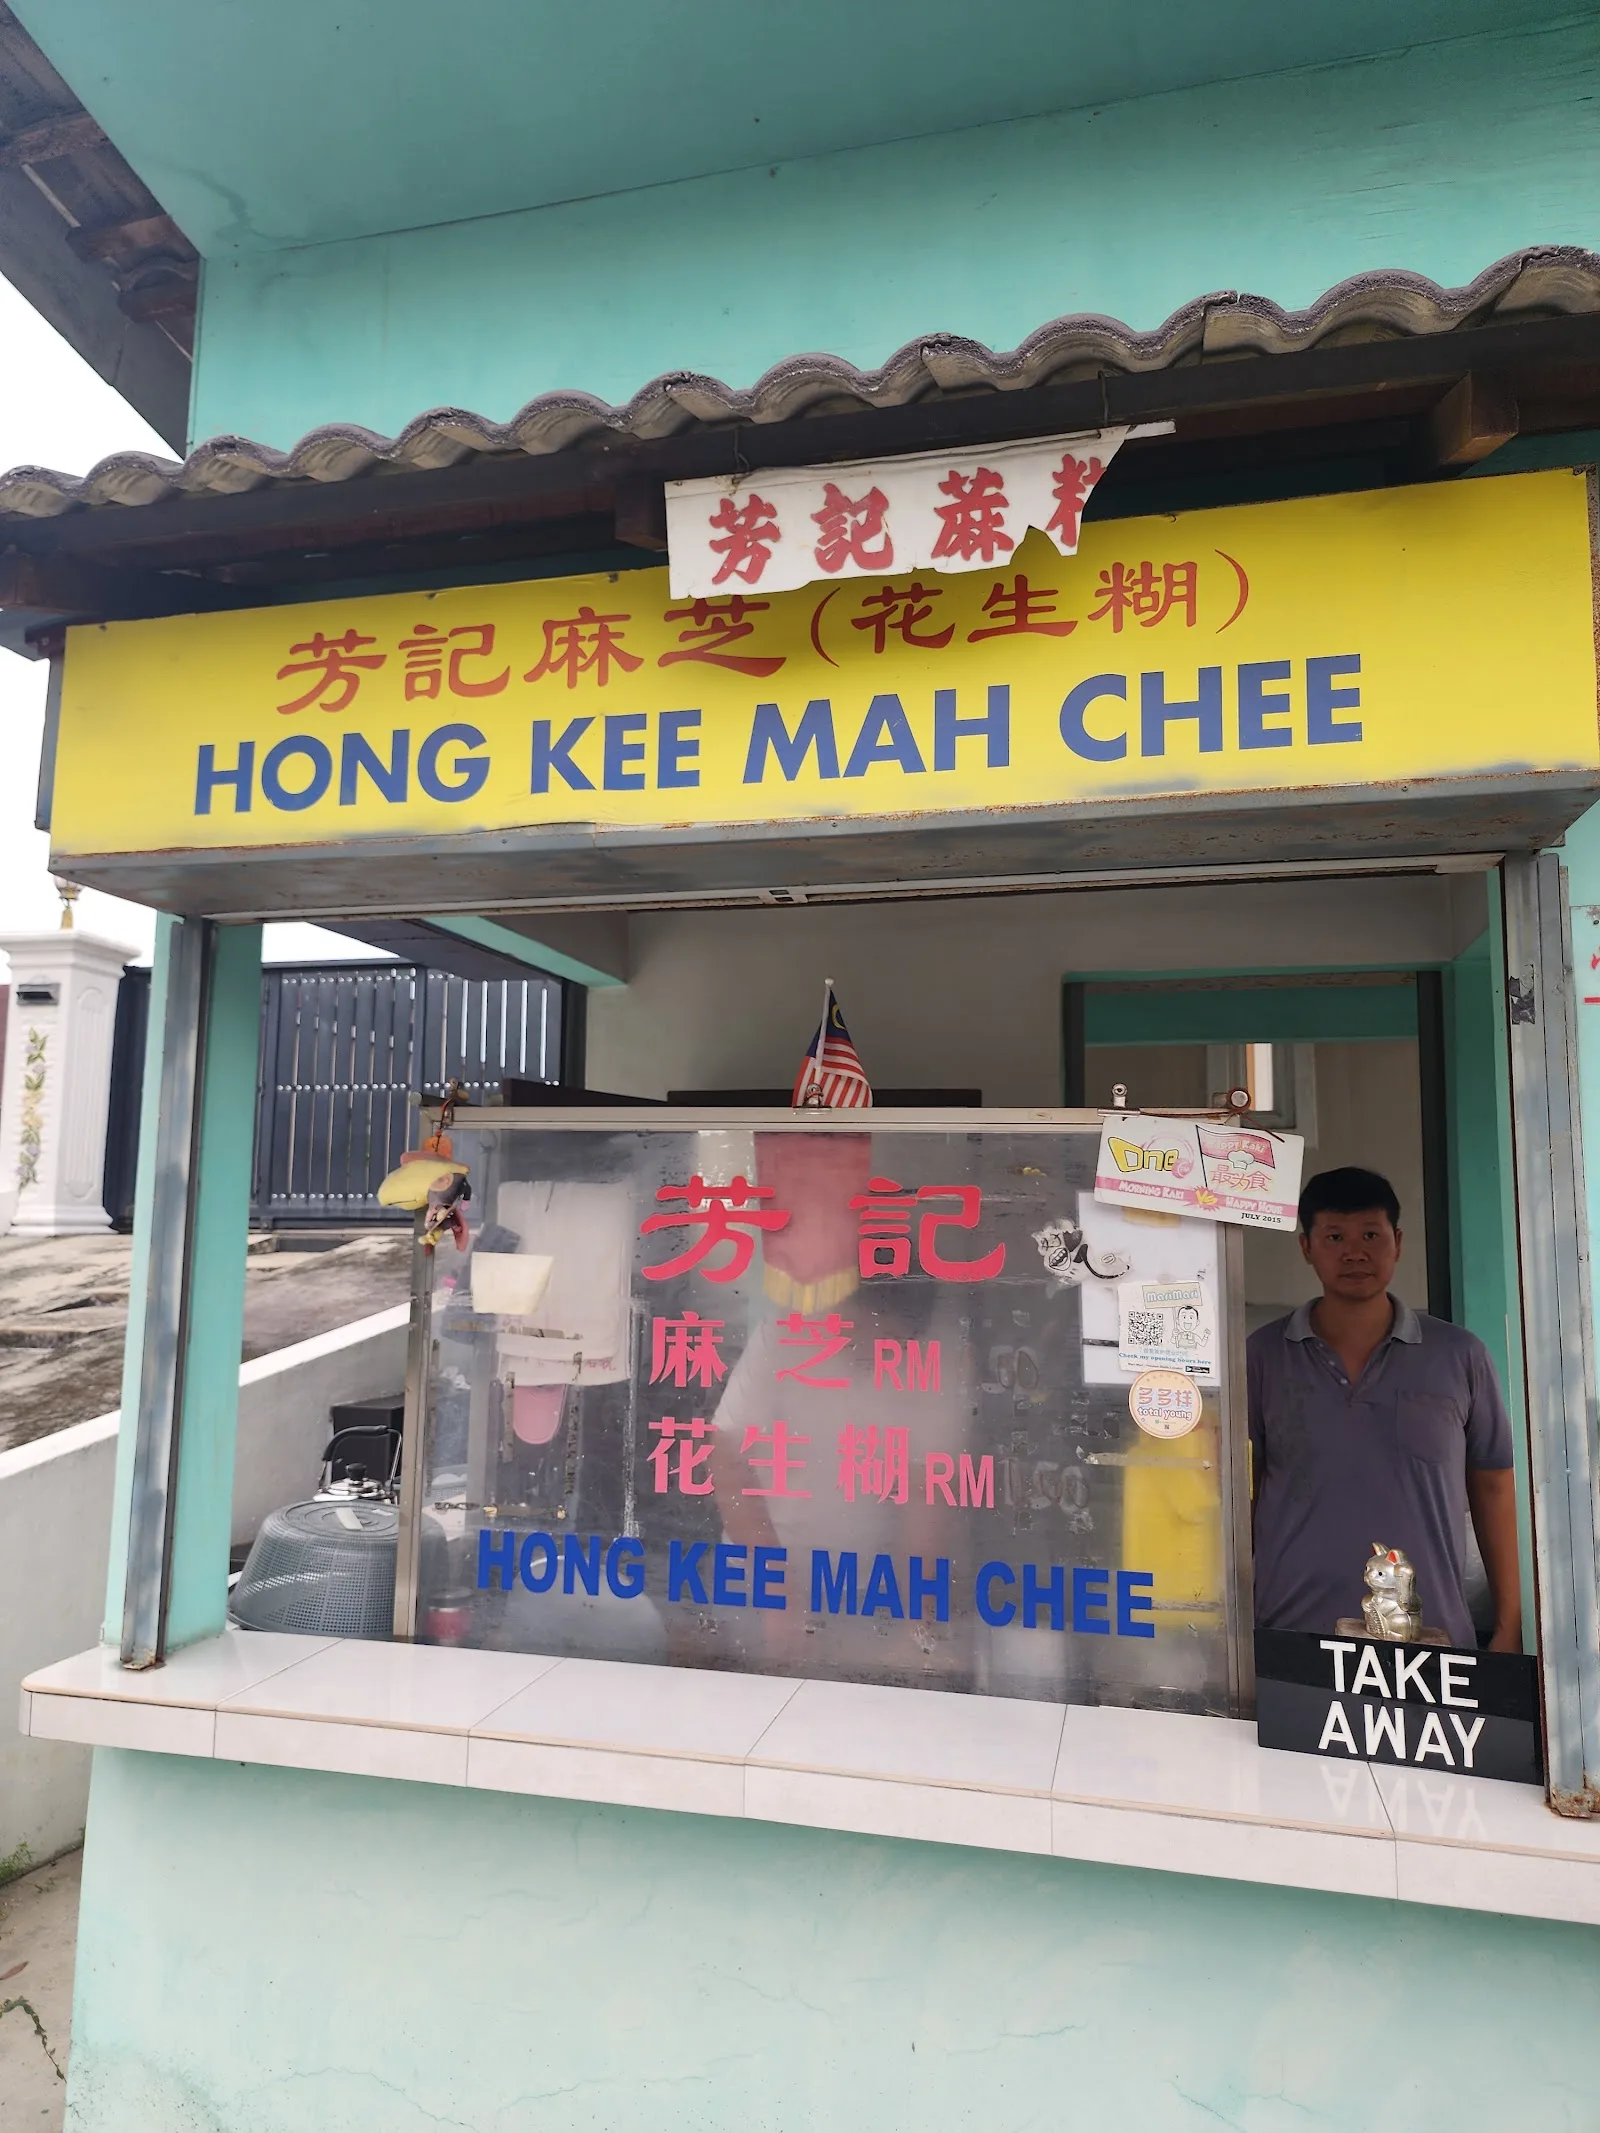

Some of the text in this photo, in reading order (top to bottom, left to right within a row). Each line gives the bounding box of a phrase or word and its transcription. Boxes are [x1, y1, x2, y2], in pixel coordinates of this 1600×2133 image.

[194, 654, 1362, 815] HONG KEE MAH CHEE
[1207, 1139, 1265, 1153] ppy Kaki
[640, 1176, 1006, 1283] 芳記
[1241, 1212, 1281, 1224] JULY 2015
[1147, 1289, 1199, 1303] MariMari
[874, 1339, 940, 1392] RM
[1137, 1407, 1193, 1421] total young
[647, 1417, 910, 1505] 花生糊
[925, 1452, 994, 1508] RM
[477, 1529, 1155, 1638] HONG KEE MAH CHEE
[1319, 1639, 1479, 1708] TAKE
[1317, 1700, 1485, 1768] AWAY
